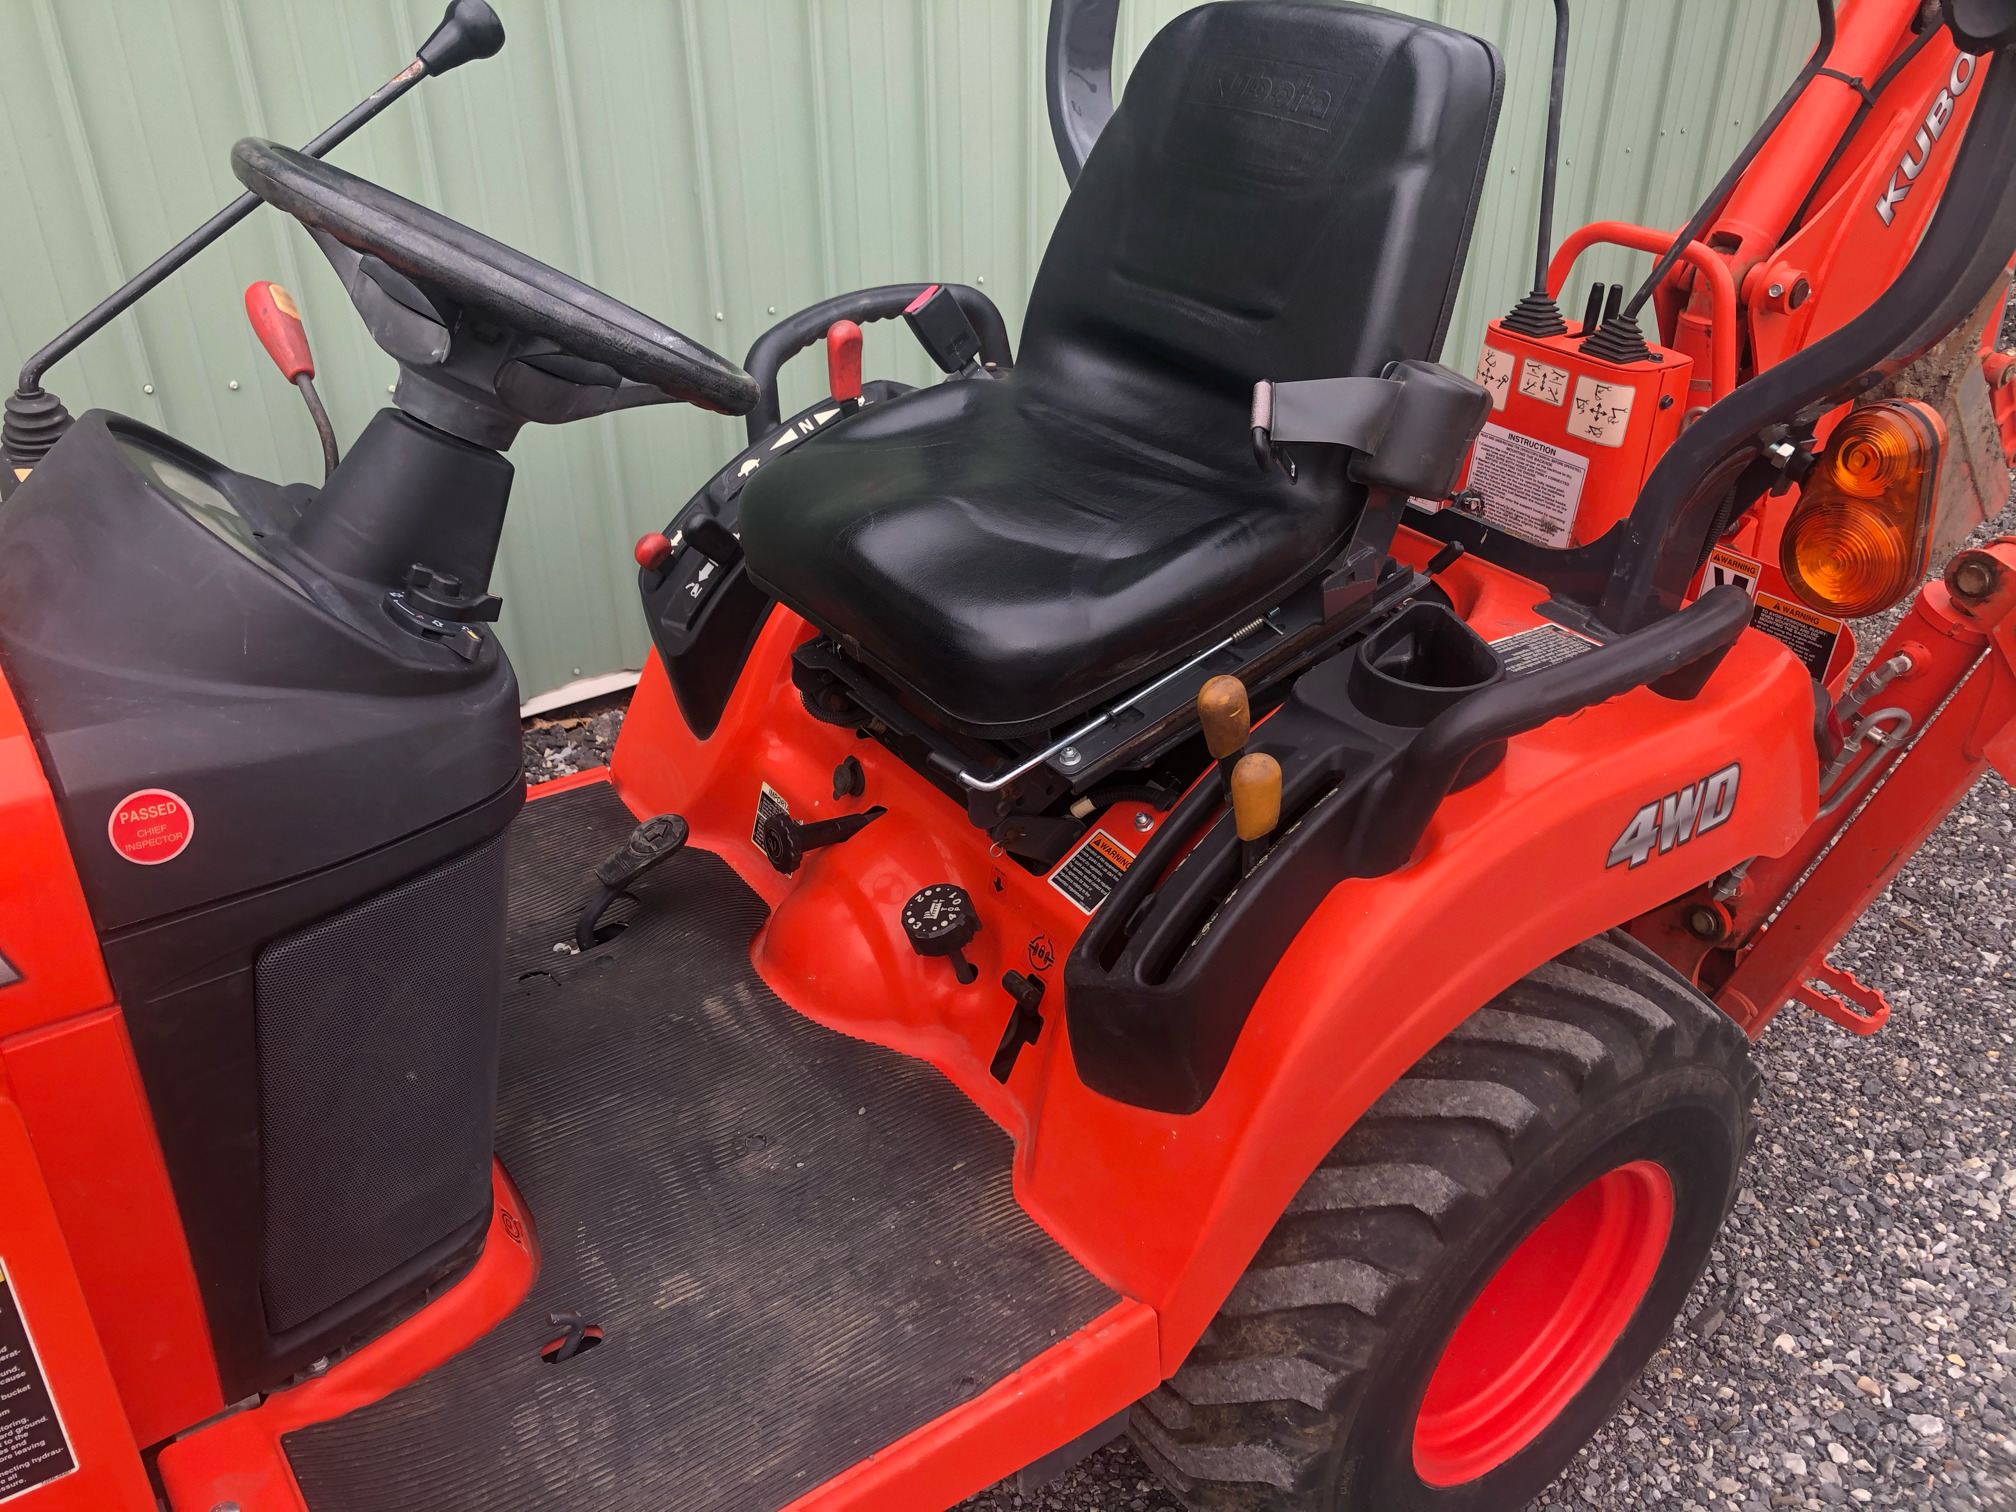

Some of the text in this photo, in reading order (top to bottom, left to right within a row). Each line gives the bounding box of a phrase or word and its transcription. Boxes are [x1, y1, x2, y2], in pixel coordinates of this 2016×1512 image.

[1875, 52, 1976, 227] KUBO
[798, 418, 815, 434] N
[1508, 432, 1556, 456] INSTRUCTION
[1721, 556, 1756, 575] WARNING
[1782, 606, 1819, 625] WARNING
[120, 802, 177, 824] PASSED
[1605, 762, 1741, 870] 4WD
[137, 825, 167, 838] CHIEF
[125, 832, 183, 852] INSPECTOR
[1, 1384, 31, 1400] bucket
[15, 1416, 48, 1434] ground.
[11, 1440, 27, 1450] and
[14, 1432, 29, 1441] the
[14, 1439, 46, 1456] leaving
[31, 1447, 64, 1464] hydrau-
[8, 1473, 18, 1481] all
